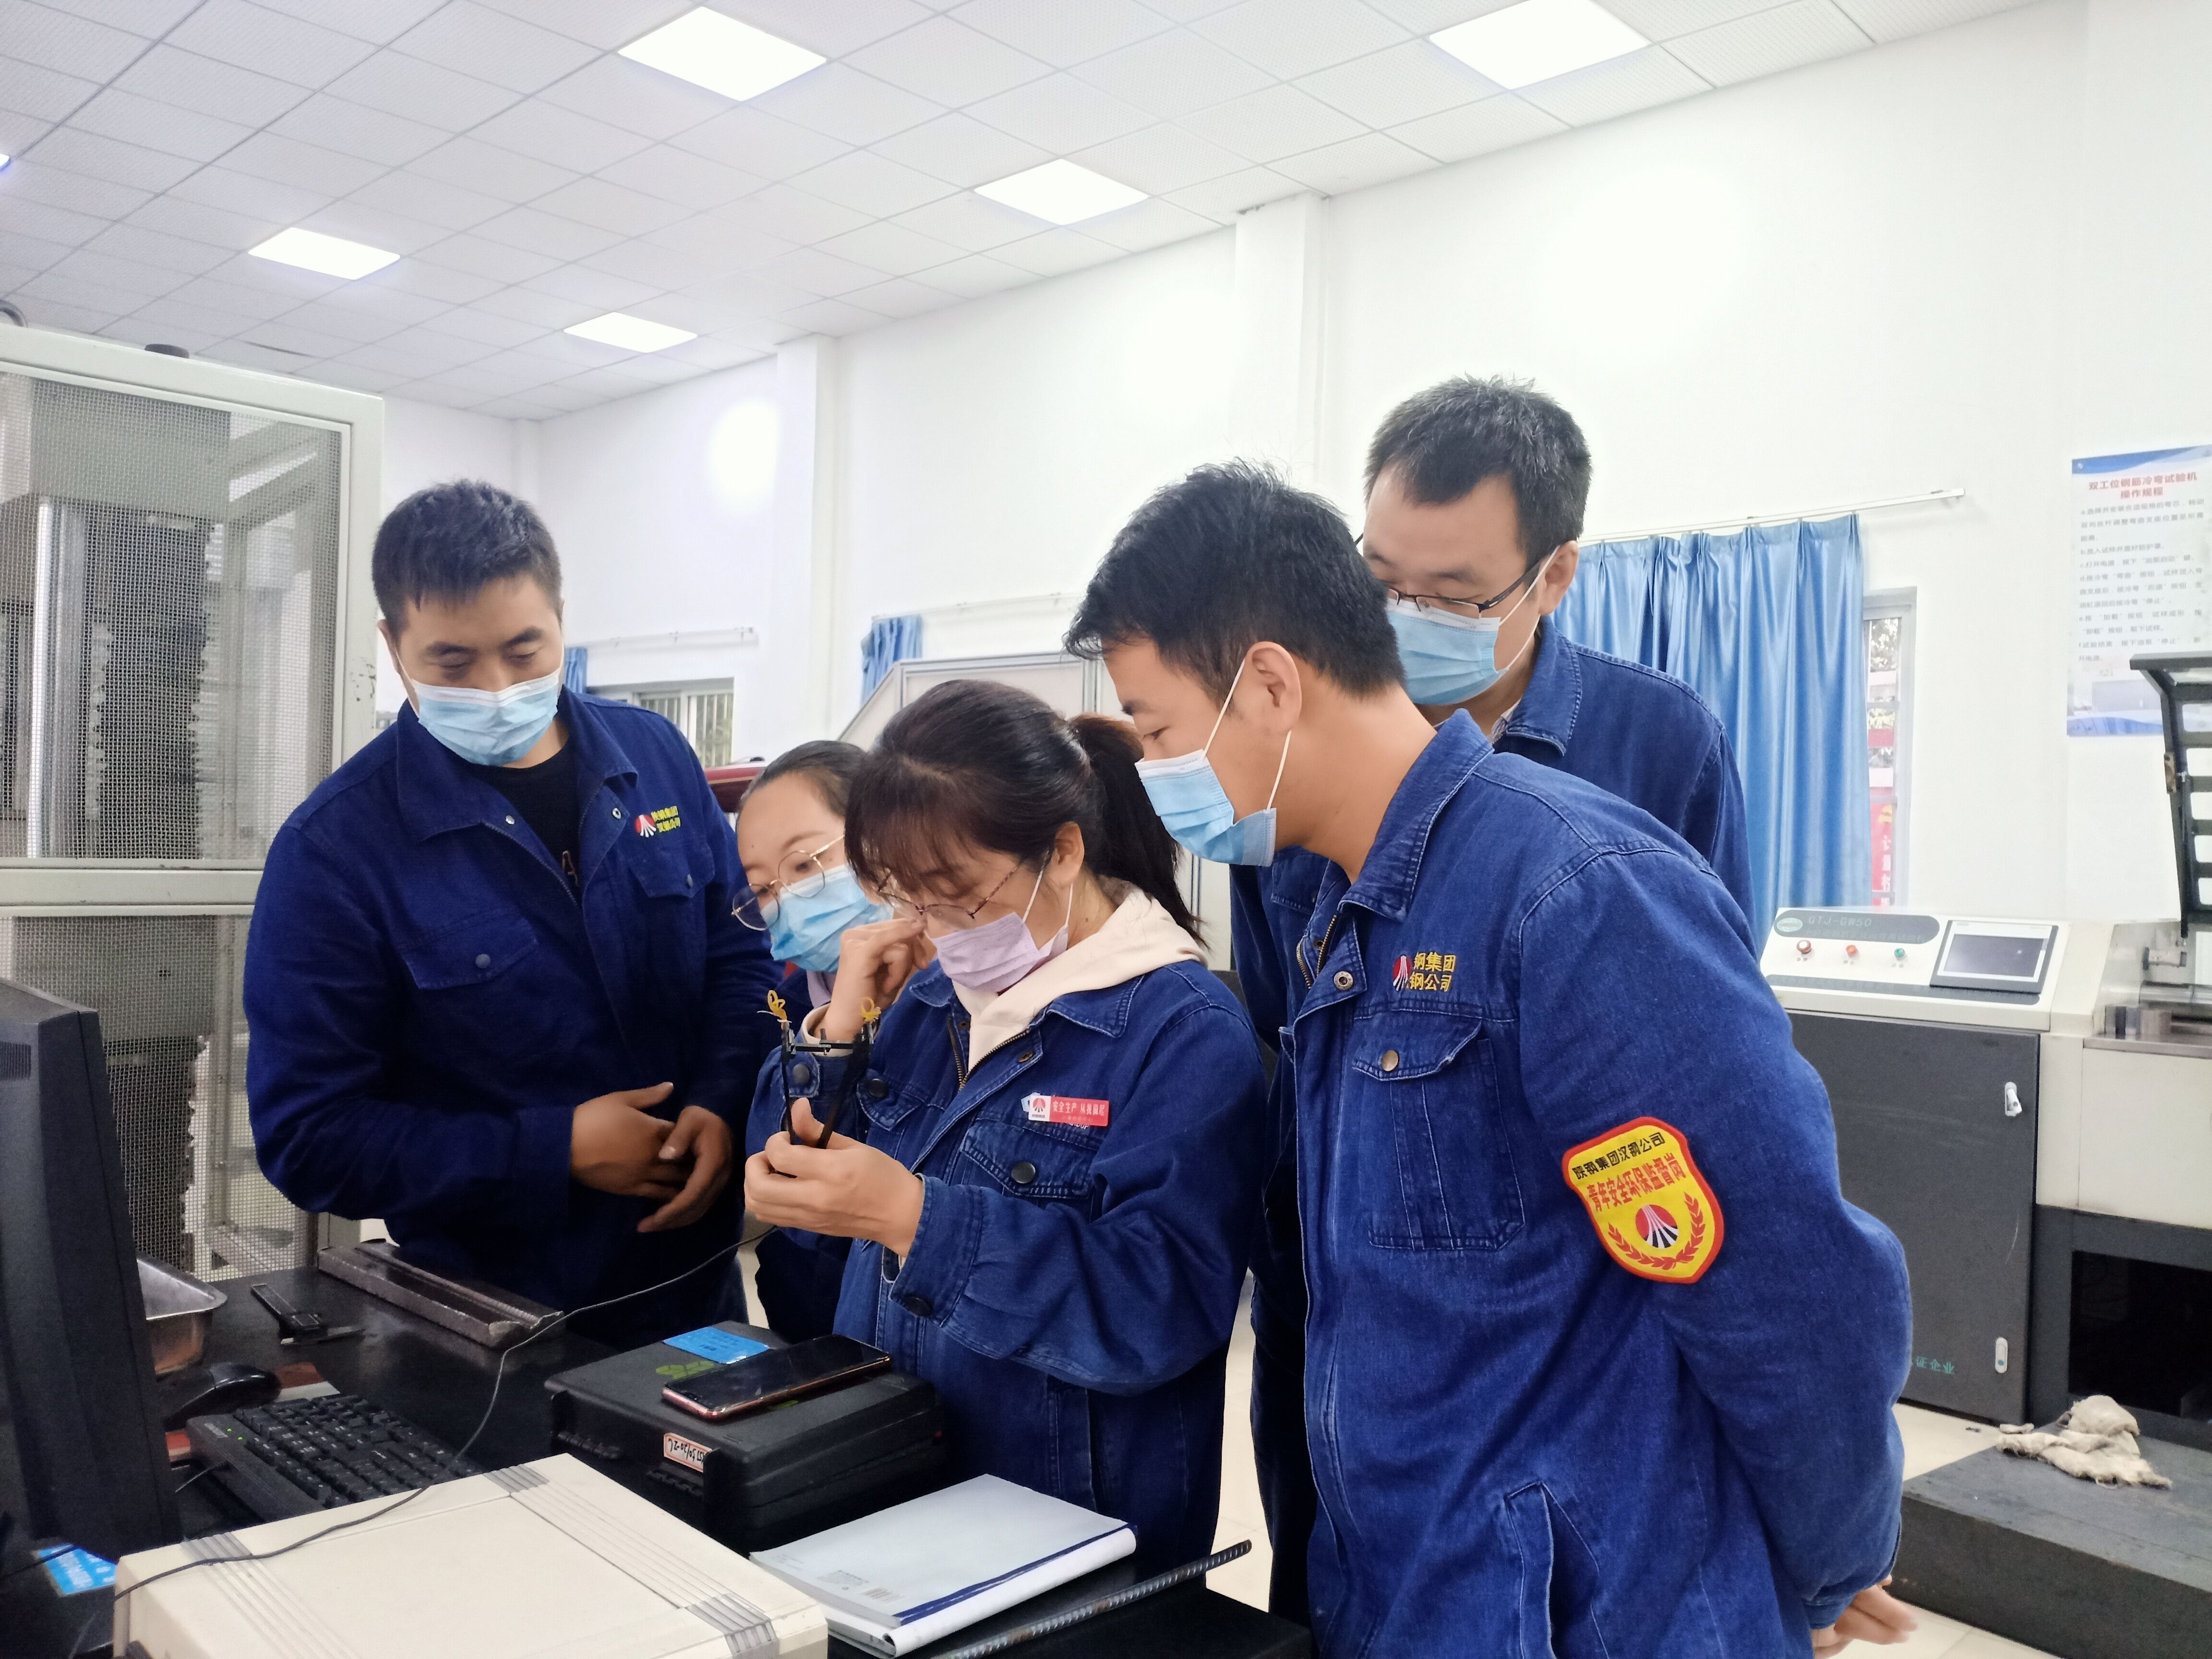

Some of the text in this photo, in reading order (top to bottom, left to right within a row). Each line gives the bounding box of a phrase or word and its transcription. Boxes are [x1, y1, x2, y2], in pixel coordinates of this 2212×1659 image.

[2090, 472, 2196, 490] 双工位钢筋冷弯试验机
[2121, 487, 2162, 498] 操作规程
[1406, 971, 1453, 992] 钢公司
[1052, 1101, 1077, 1114] 安全生产
[1572, 1131, 1666, 1180] 陕钢集团汉钢公司
[1586, 1152, 1687, 1213] 青年安全环保监督岗
[1916, 1355, 1955, 1375] 证企业
